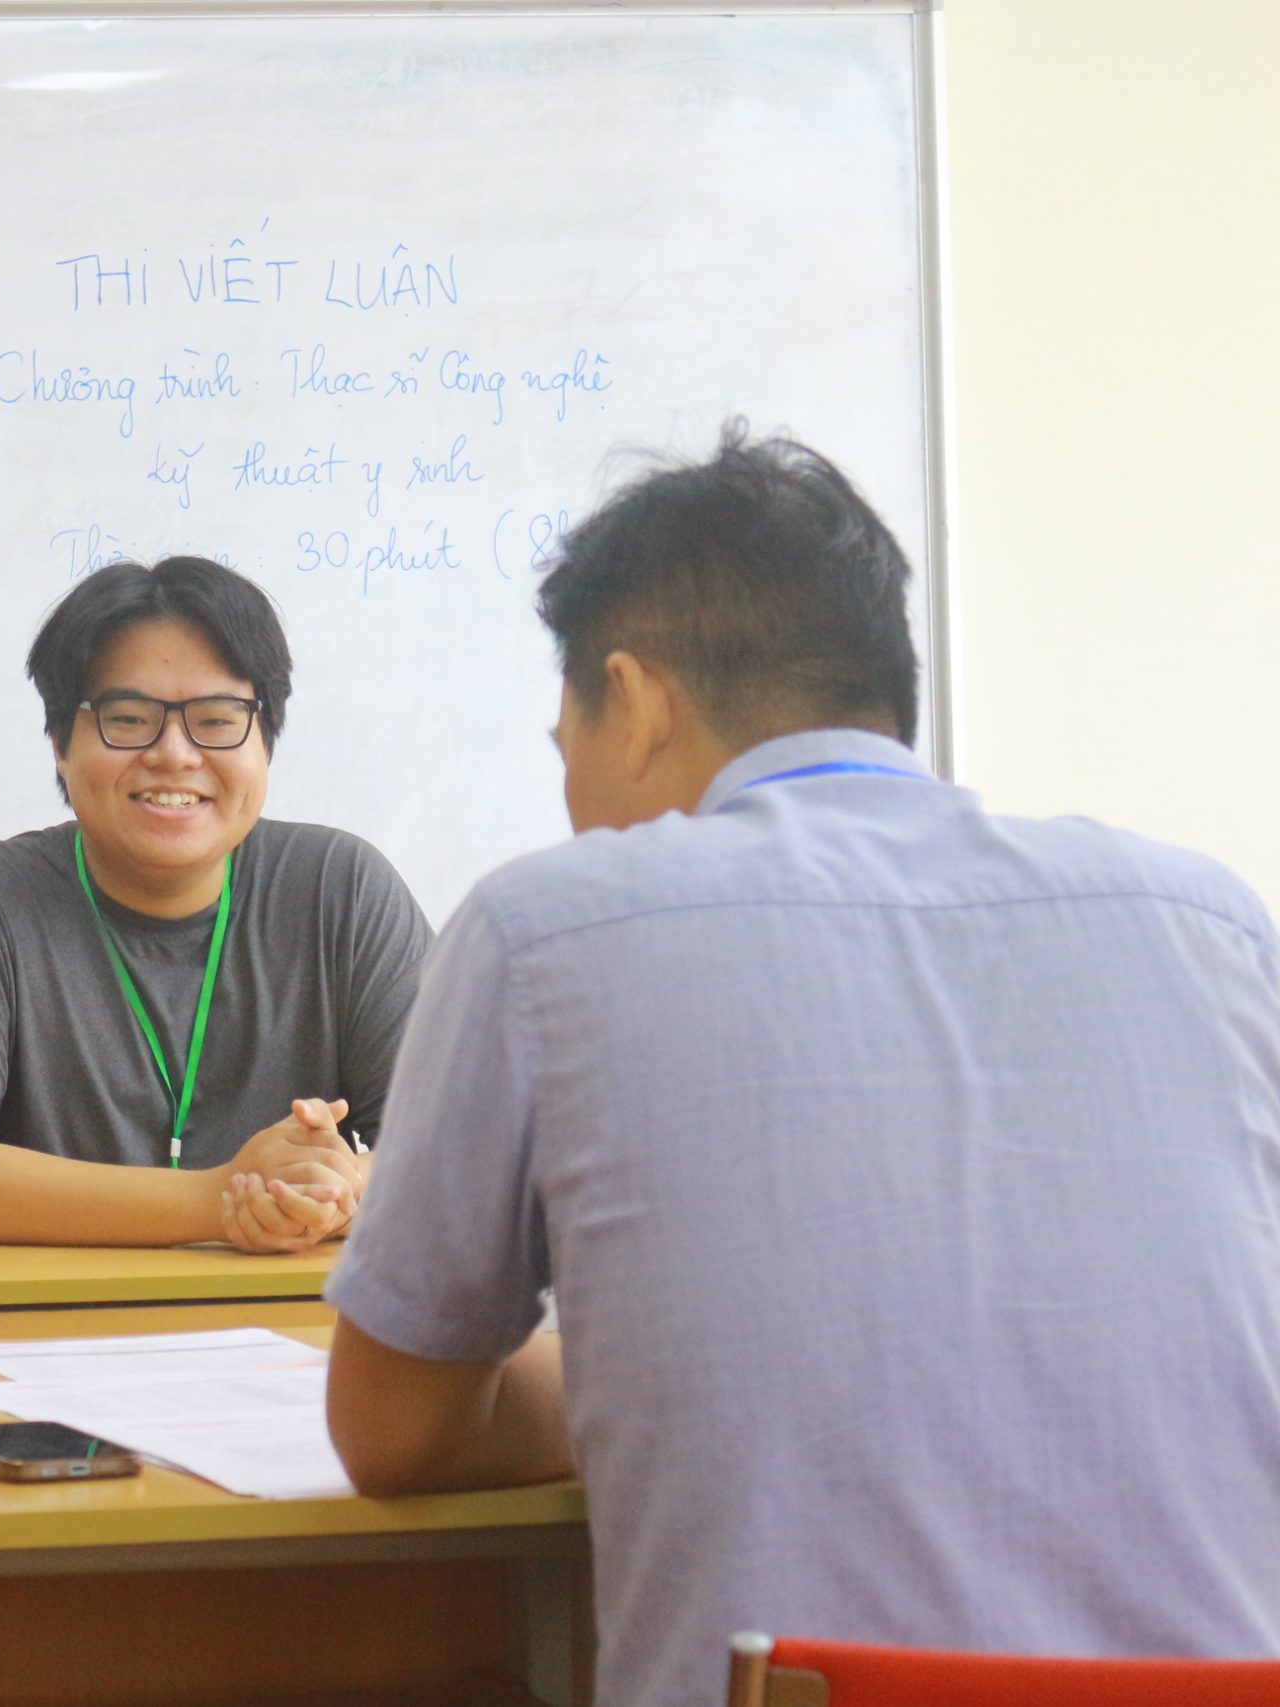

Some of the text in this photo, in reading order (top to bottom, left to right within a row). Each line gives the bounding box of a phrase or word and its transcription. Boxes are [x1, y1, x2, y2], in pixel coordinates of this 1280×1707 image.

[324, 243, 459, 317] LUẬN
[280, 343, 375, 407] Thạc
[384, 347, 429, 398] sĩ
[521, 348, 614, 422] nghệ
[232, 440, 351, 493] thuật
[361, 461, 383, 518] y
[406, 434, 485, 491] sinh
[296, 531, 349, 572] 30
[354, 519, 462, 596] phút
